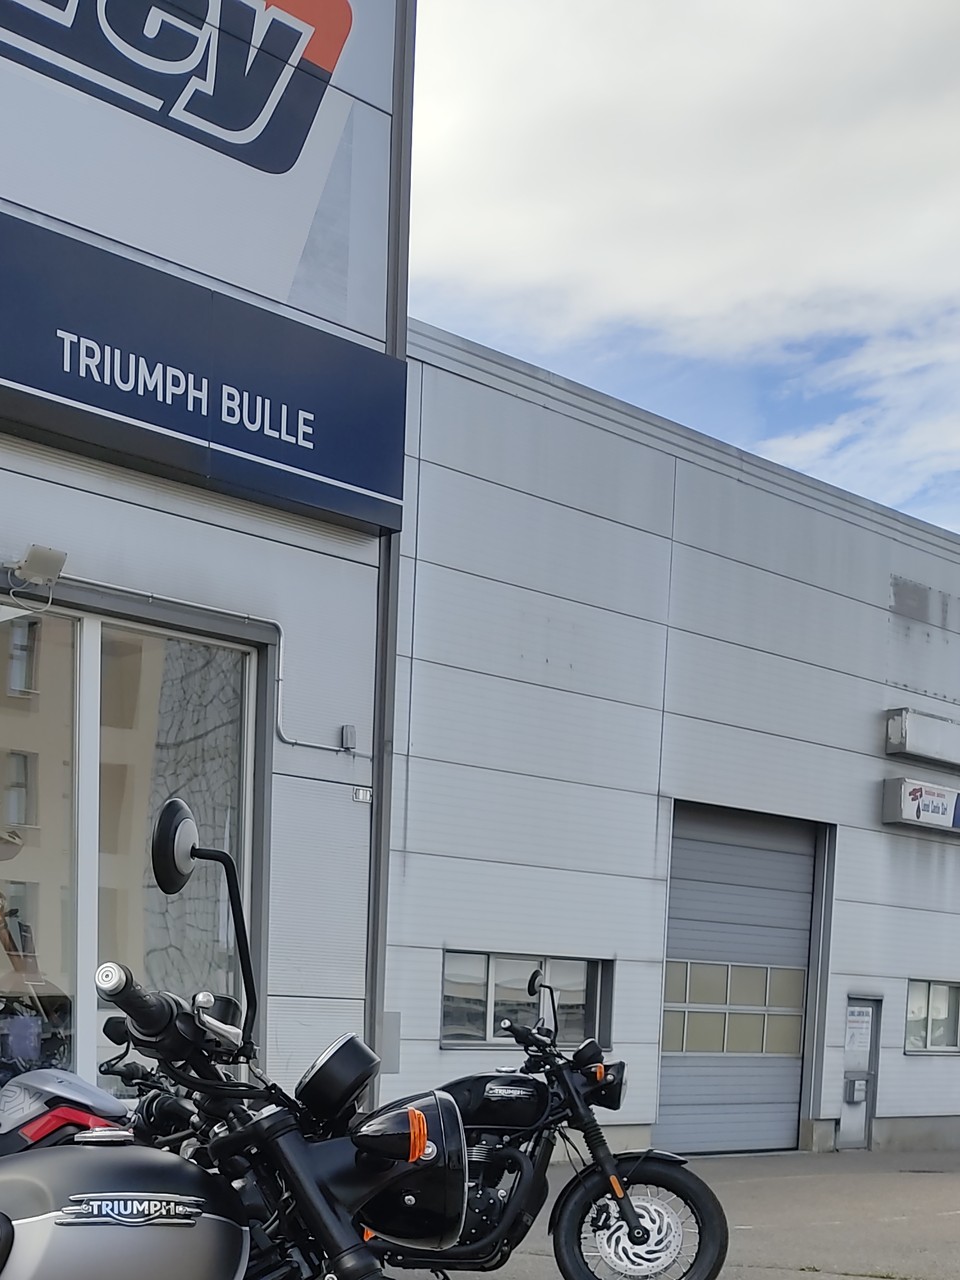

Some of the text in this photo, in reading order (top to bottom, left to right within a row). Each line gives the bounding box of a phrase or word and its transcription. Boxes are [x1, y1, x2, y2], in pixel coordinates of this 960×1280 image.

[56, 328, 315, 450] TRIUMPH BULLE
[89, 1200, 177, 1217] TRIUMPH
